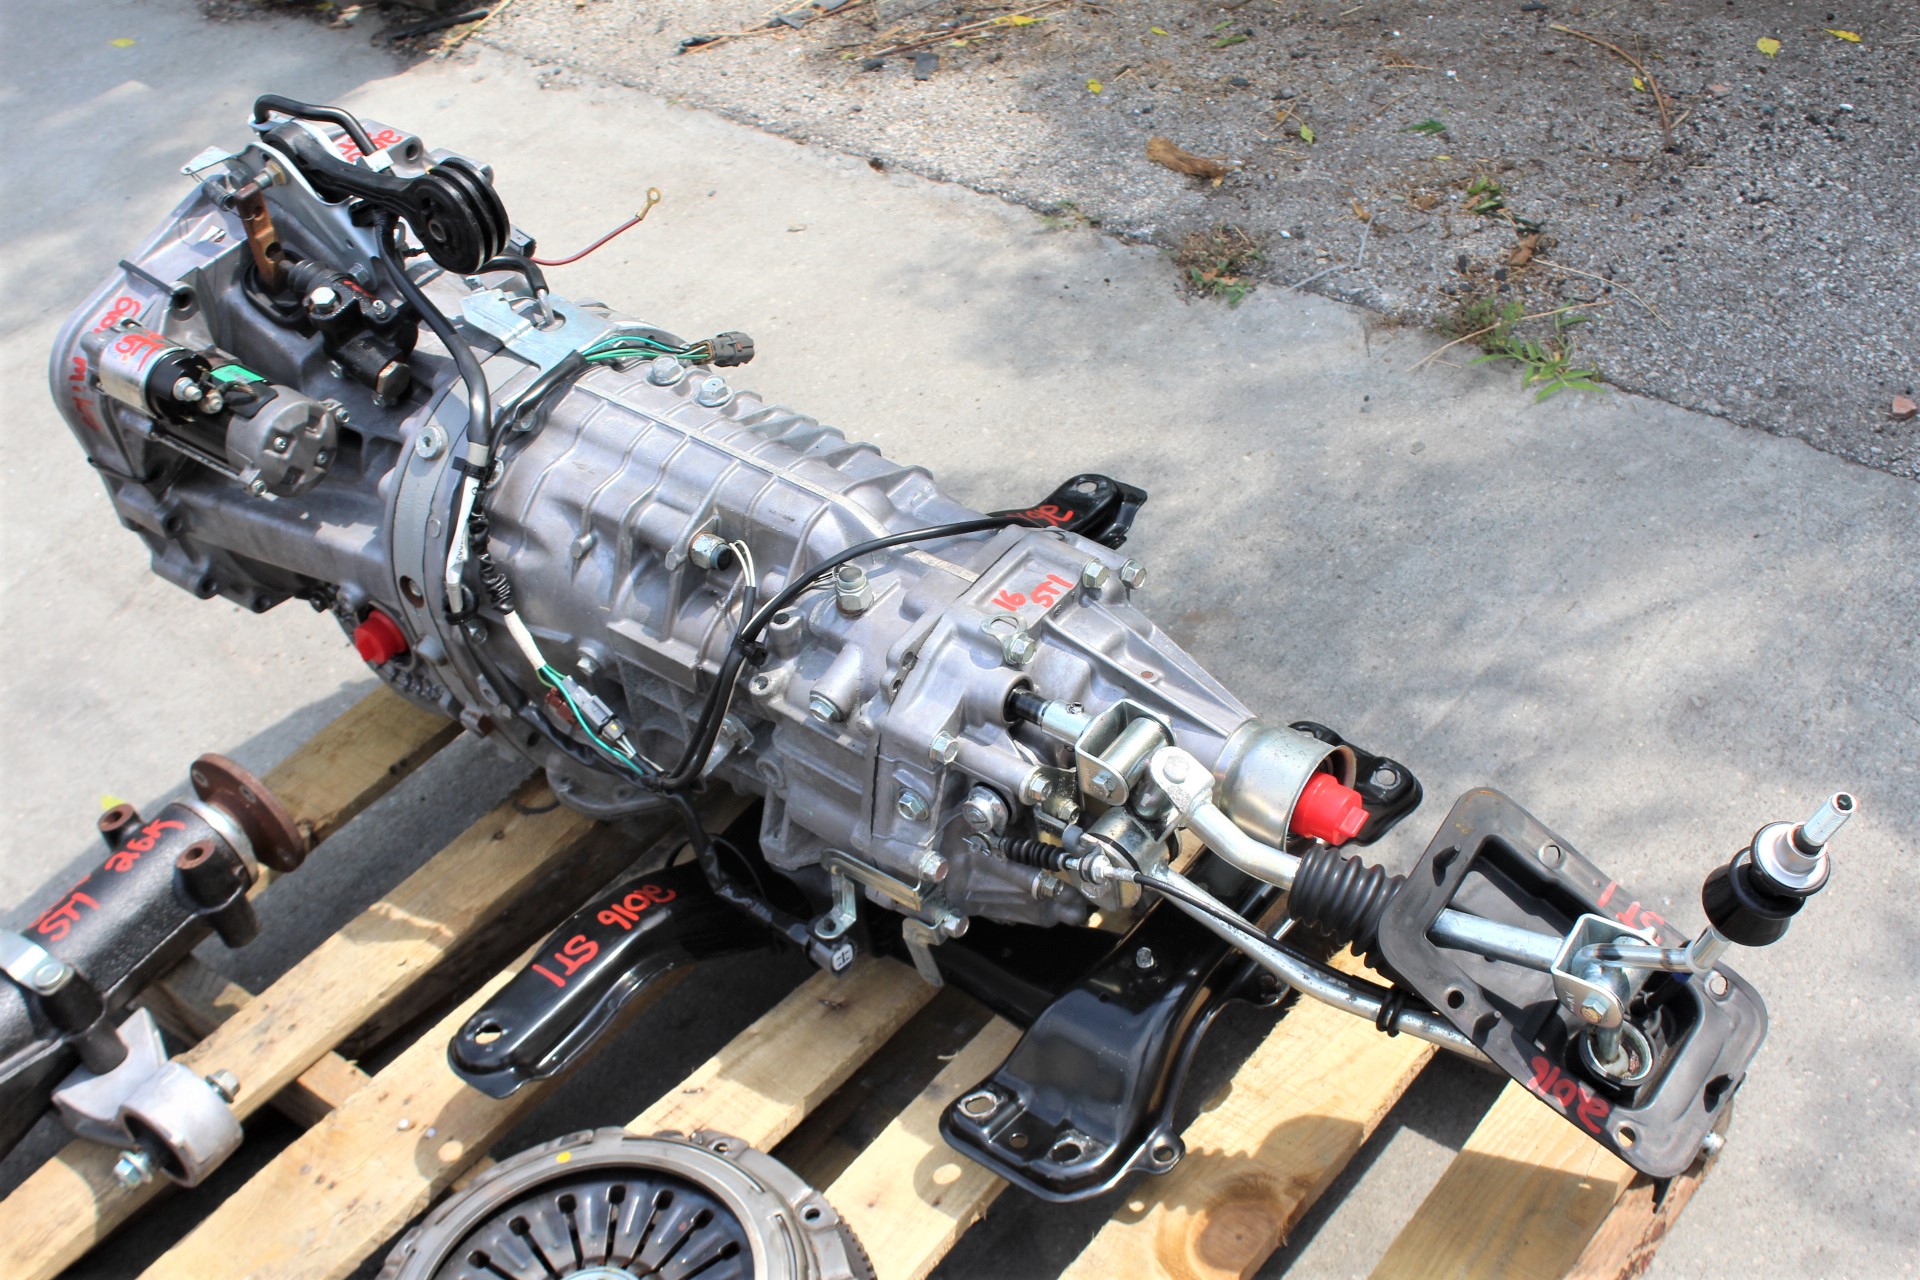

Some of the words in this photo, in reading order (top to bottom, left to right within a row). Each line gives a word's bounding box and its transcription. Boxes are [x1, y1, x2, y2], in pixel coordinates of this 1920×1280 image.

[992, 589, 1027, 611] 16
[38, 892, 101, 942] STI
[597, 884, 676, 930] 2016
[531, 934, 599, 988] STI
[1527, 1055, 1610, 1134] 2016
